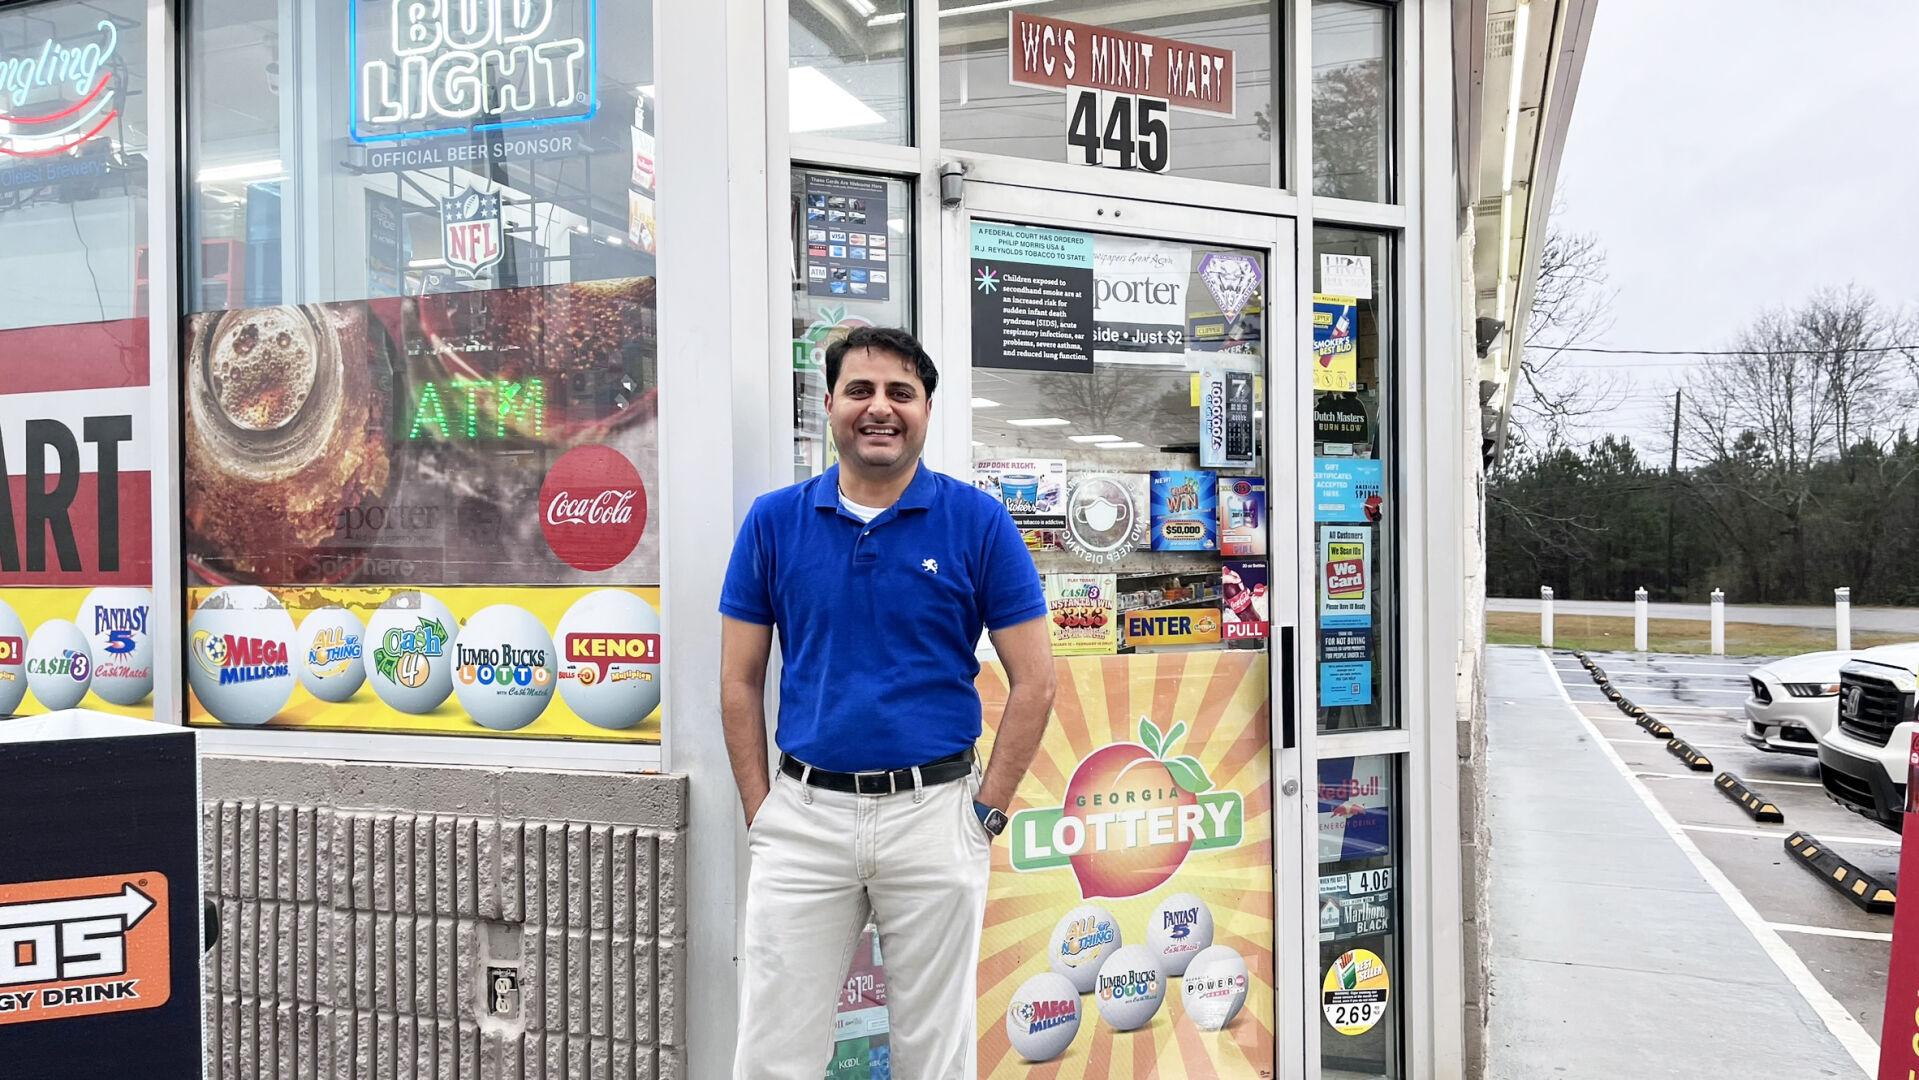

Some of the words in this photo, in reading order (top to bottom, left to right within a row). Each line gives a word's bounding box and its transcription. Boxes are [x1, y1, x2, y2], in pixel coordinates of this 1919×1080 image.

[391, 0, 552, 56] BUD
[1021, 21, 1076, 80] WC'S
[1091, 34, 1154, 91] MINIT
[1167, 48, 1224, 102] MART
[362, 38, 585, 123] LIGHT
[1067, 90, 1170, 174] 445
[372, 149, 442, 168] OFFICIAL
[447, 144, 488, 163] BEER
[493, 136, 572, 158] SPONSOR
[450, 223, 498, 265] NFL
[984, 228, 1015, 238] FEDERAL
[1015, 231, 1038, 240] COURT
[1054, 235, 1084, 244] ORDERED
[998, 239, 1019, 247] PHILIP
[1020, 241, 1045, 250] MORRIS
[988, 246, 1023, 256] REYNOLDS
[1025, 250, 1056, 259] TOBACCO
[1003, 274, 1032, 284] Children
[1033, 277, 1058, 287] exposed
[1003, 285, 1042, 295] secondhand
[1043, 288, 1063, 297] smoke
[1003, 306, 1026, 315] sudden
[1028, 308, 1047, 316] infant
[1048, 310, 1067, 318] death
[1012, 296, 1043, 306] increased
[1044, 299, 1057, 307] risk
[1003, 317, 1035, 327] syndrome
[1003, 328, 1039, 338] respiratory
[1040, 330, 1074, 340] infections,
[1003, 338, 1035, 348] problems,
[1057, 342, 1083, 351] asthma,
[1132, 329, 1163, 344] Just
[1167, 329, 1183, 345] $2
[1017, 350, 1042, 358] reduced
[1043, 350, 1058, 360] lung
[1059, 352, 1088, 361] function.
[409, 378, 542, 439] ATM
[1314, 410, 1335, 422] Dutch
[1336, 411, 1365, 423] Masters
[1318, 423, 1340, 431] BURN
[1167, 493, 1199, 513] WIN
[1166, 525, 1200, 535] $50,000
[1340, 546, 1352, 555] Scan
[363, 555, 415, 577] here
[1333, 562, 1357, 576] We
[1328, 573, 1363, 589] Card
[95, 605, 149, 636] FANTASY
[1129, 616, 1192, 637] ENTER
[1227, 624, 1262, 637] PULL
[104, 630, 136, 654] 5
[312, 627, 344, 647] ALL
[223, 634, 289, 667] MEGA
[308, 643, 362, 666] NOTHING
[456, 644, 499, 671] JUMBO
[501, 643, 545, 667] BUCKS
[572, 638, 655, 658] KENO!
[73, 653, 87, 676] 3
[401, 654, 421, 686] 4
[460, 665, 549, 684] LOTTO
[219, 666, 290, 686] MILLIONS
[1350, 775, 1379, 797] Bull
[1076, 786, 1180, 808] GEORGIA
[1024, 800, 1235, 859] LOTTERY
[1361, 869, 1389, 892] 4.06
[1163, 907, 1199, 930] FANTASY
[1344, 902, 1386, 924] Marlboro
[1066, 915, 1096, 938] ALL
[1170, 923, 1190, 939] 5
[1357, 918, 1388, 934] BLACK
[1061, 929, 1114, 955] NOTHING
[1099, 974, 1127, 993] JUMBO
[1128, 970, 1156, 985] BUCKS
[1101, 982, 1158, 1000] LOTTO
[42, 980, 139, 1007] DRINK
[1031, 999, 1076, 1023] MEGA
[1336, 1003, 1371, 1026] 2.69
[1029, 1012, 1077, 1035] MILLIONS
[838, 1058, 860, 1069] KOOL
